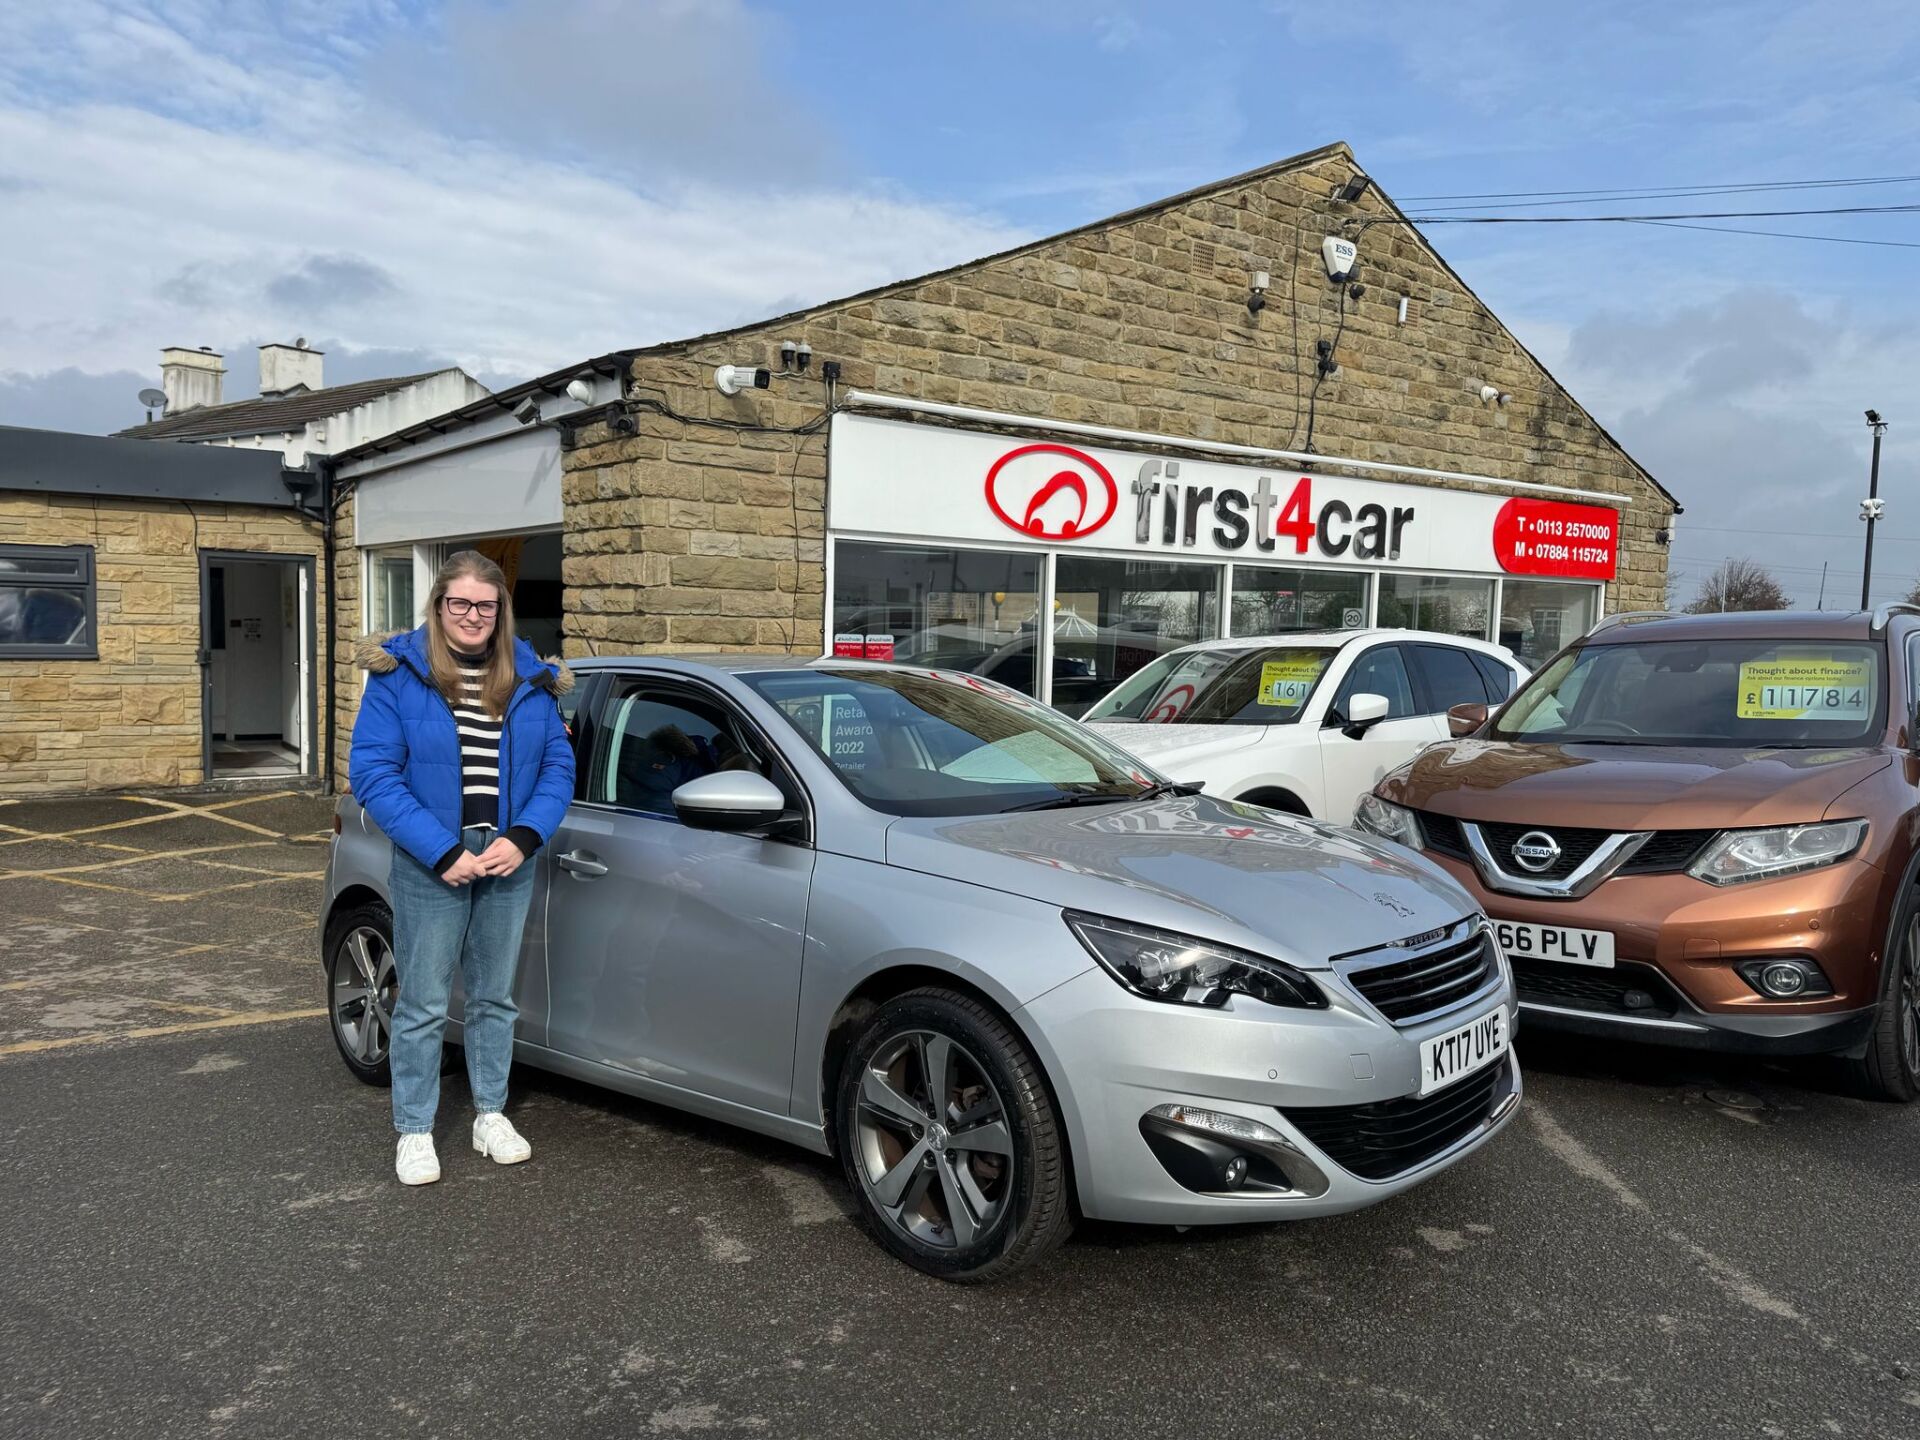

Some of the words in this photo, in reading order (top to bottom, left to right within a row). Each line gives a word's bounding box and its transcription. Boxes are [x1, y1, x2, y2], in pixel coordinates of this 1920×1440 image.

[1336, 244, 1353, 256] ESS
[1131, 460, 1414, 560] first4car
[1517, 516, 1526, 532] T
[1537, 519, 1562, 535] 0113
[1566, 522, 1610, 540] 2570000
[1515, 541, 1525, 557] M
[1536, 544, 1568, 560] 07884
[1572, 547, 1608, 563] 115724
[1346, 614, 1359, 623] 20
[1267, 665, 1290, 673] Thought
[1291, 665, 1309, 673] about
[1748, 667, 1786, 675] Thought
[1789, 667, 1817, 675] about
[1820, 667, 1862, 675] finance?
[835, 741, 864, 754] 2022
[1516, 846, 1555, 856] NISSAN
[1492, 922, 1532, 951] 66
[1541, 929, 1598, 960] PLV
[1433, 1029, 1471, 1081] KT17
[1475, 1013, 1500, 1059] UYE
